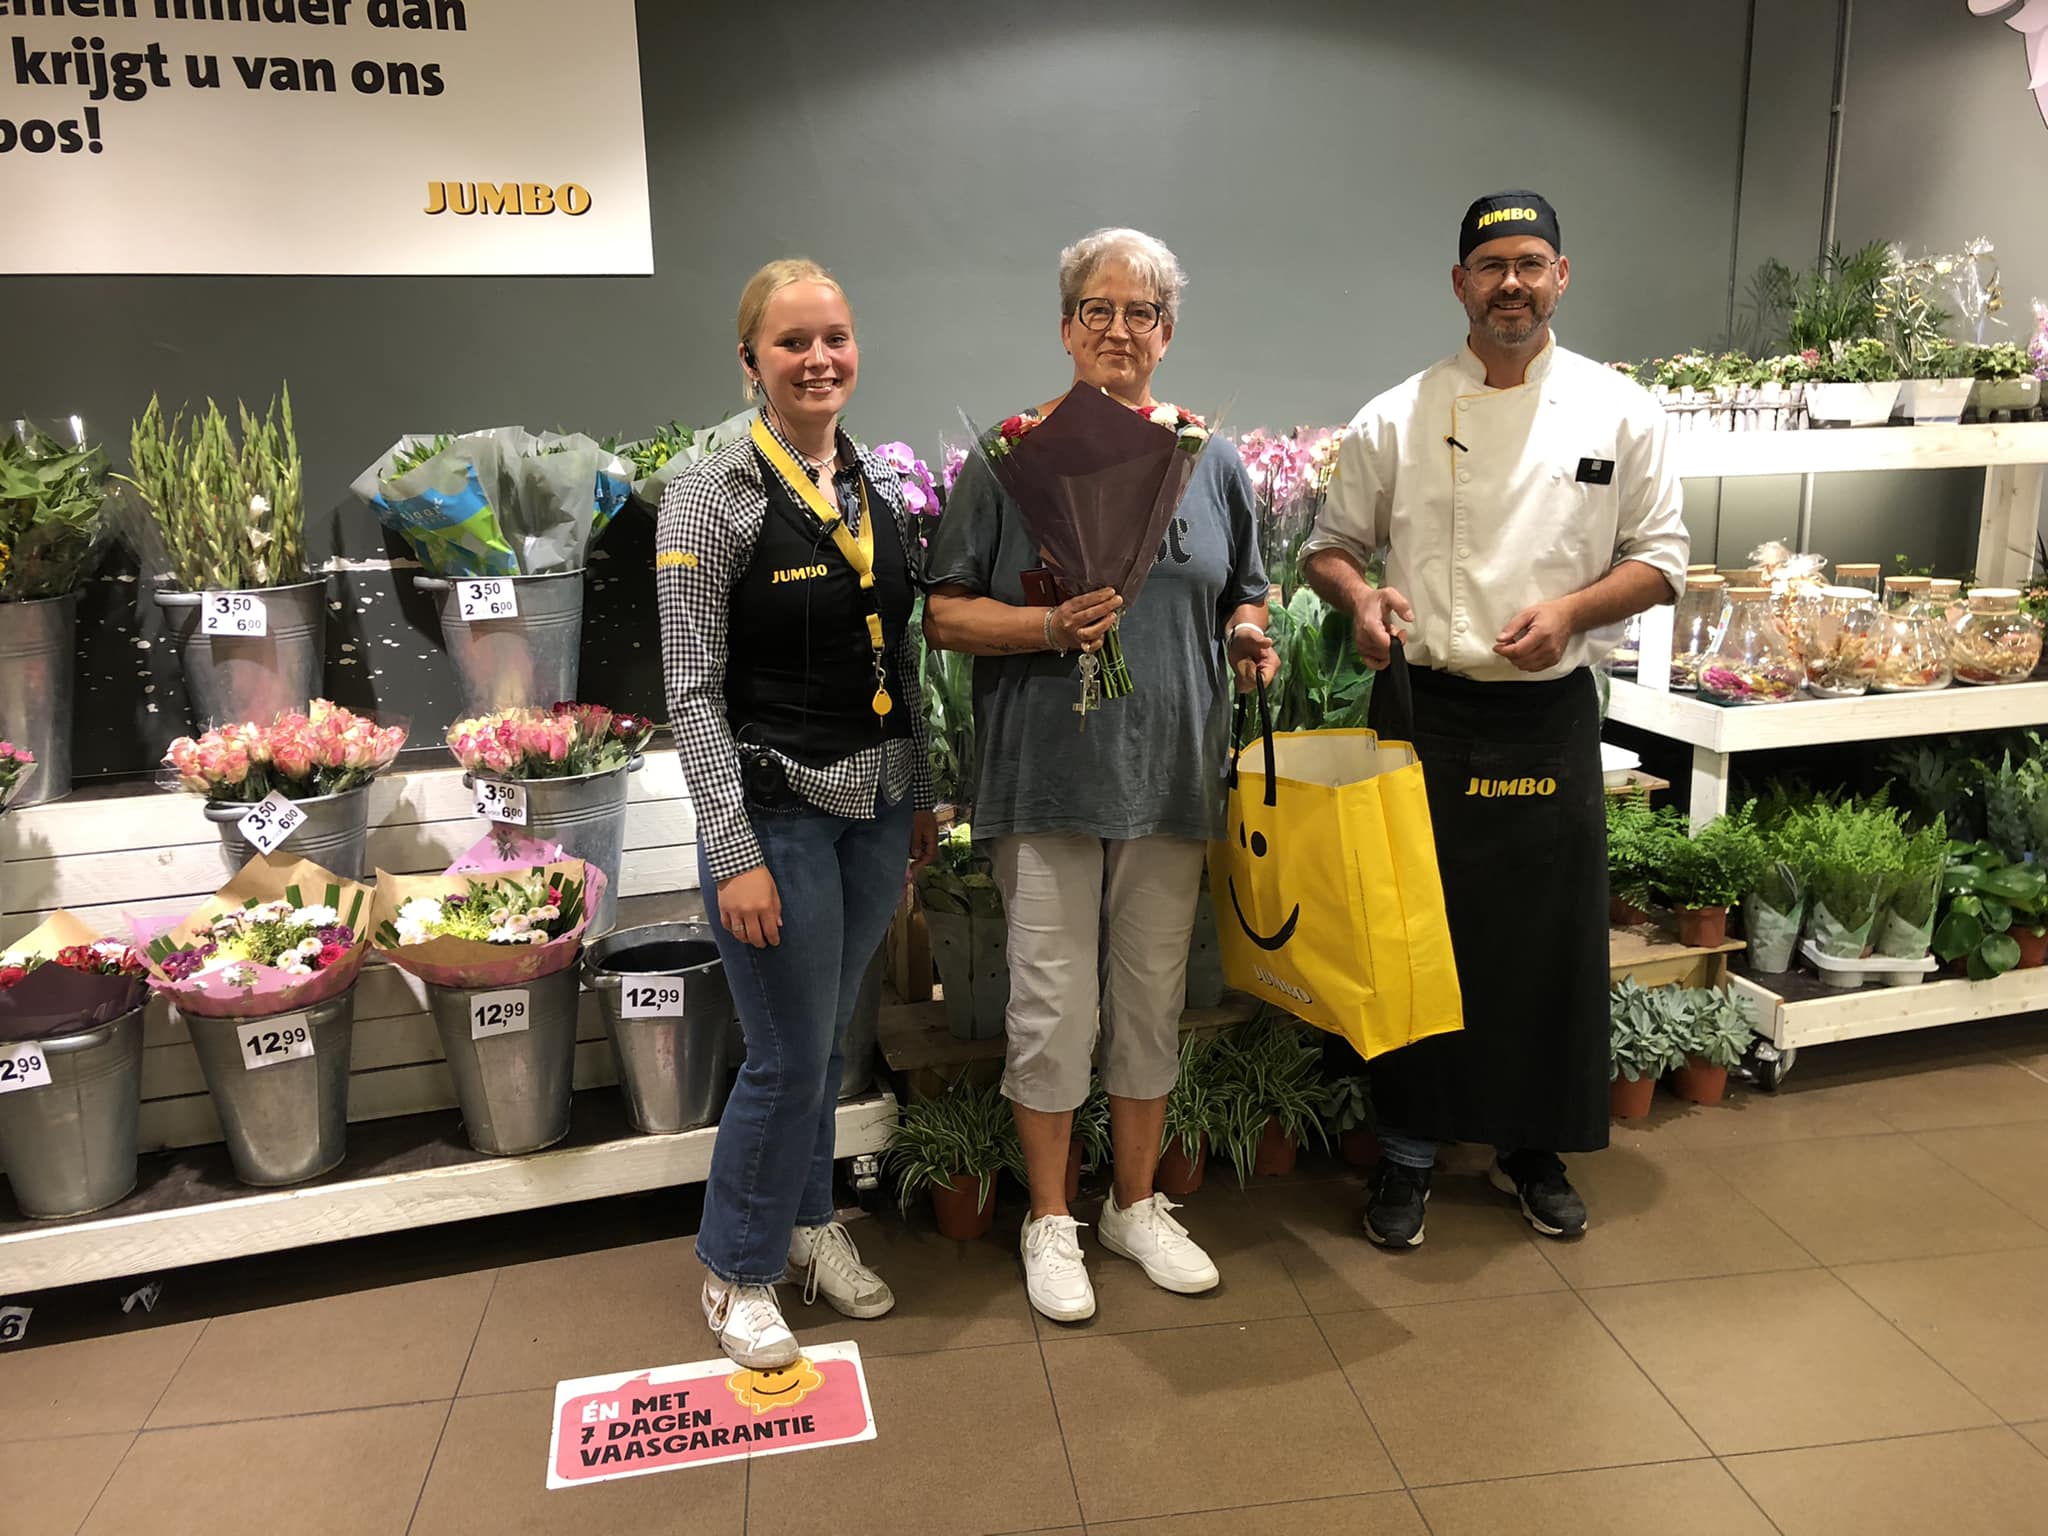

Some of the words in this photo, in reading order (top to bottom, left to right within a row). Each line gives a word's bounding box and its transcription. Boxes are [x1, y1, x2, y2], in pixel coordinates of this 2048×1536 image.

[0, 0, 137, 17] men
[367, 0, 467, 31] dan
[11, 36, 171, 101] krijgt
[185, 54, 220, 88] u
[232, 56, 336, 92] van
[351, 60, 445, 96] ons
[424, 181, 592, 216] JUMBO
[1477, 208, 1537, 230] JUMBO
[771, 564, 828, 583] JUMBO
[470, 582, 501, 602] 3,50
[216, 597, 251, 617] 3,50
[464, 603, 475, 615] 2
[207, 617, 218, 629] 2
[485, 784, 515, 804] 3,50
[1464, 777, 1557, 798] JUMBO
[248, 801, 277, 830] 3,50
[477, 802, 486, 814] 2
[258, 835, 271, 848] 2
[626, 988, 680, 1010] 12,99
[475, 1002, 525, 1027] 12,99
[247, 1027, 306, 1056] 12,99
[582, 1399, 620, 1424] ÉN
[632, 1390, 690, 1416] MET
[581, 1426, 596, 1445] 7
[608, 1409, 711, 1441] DAGEN
[580, 1415, 816, 1467] VAASGARANTIE
